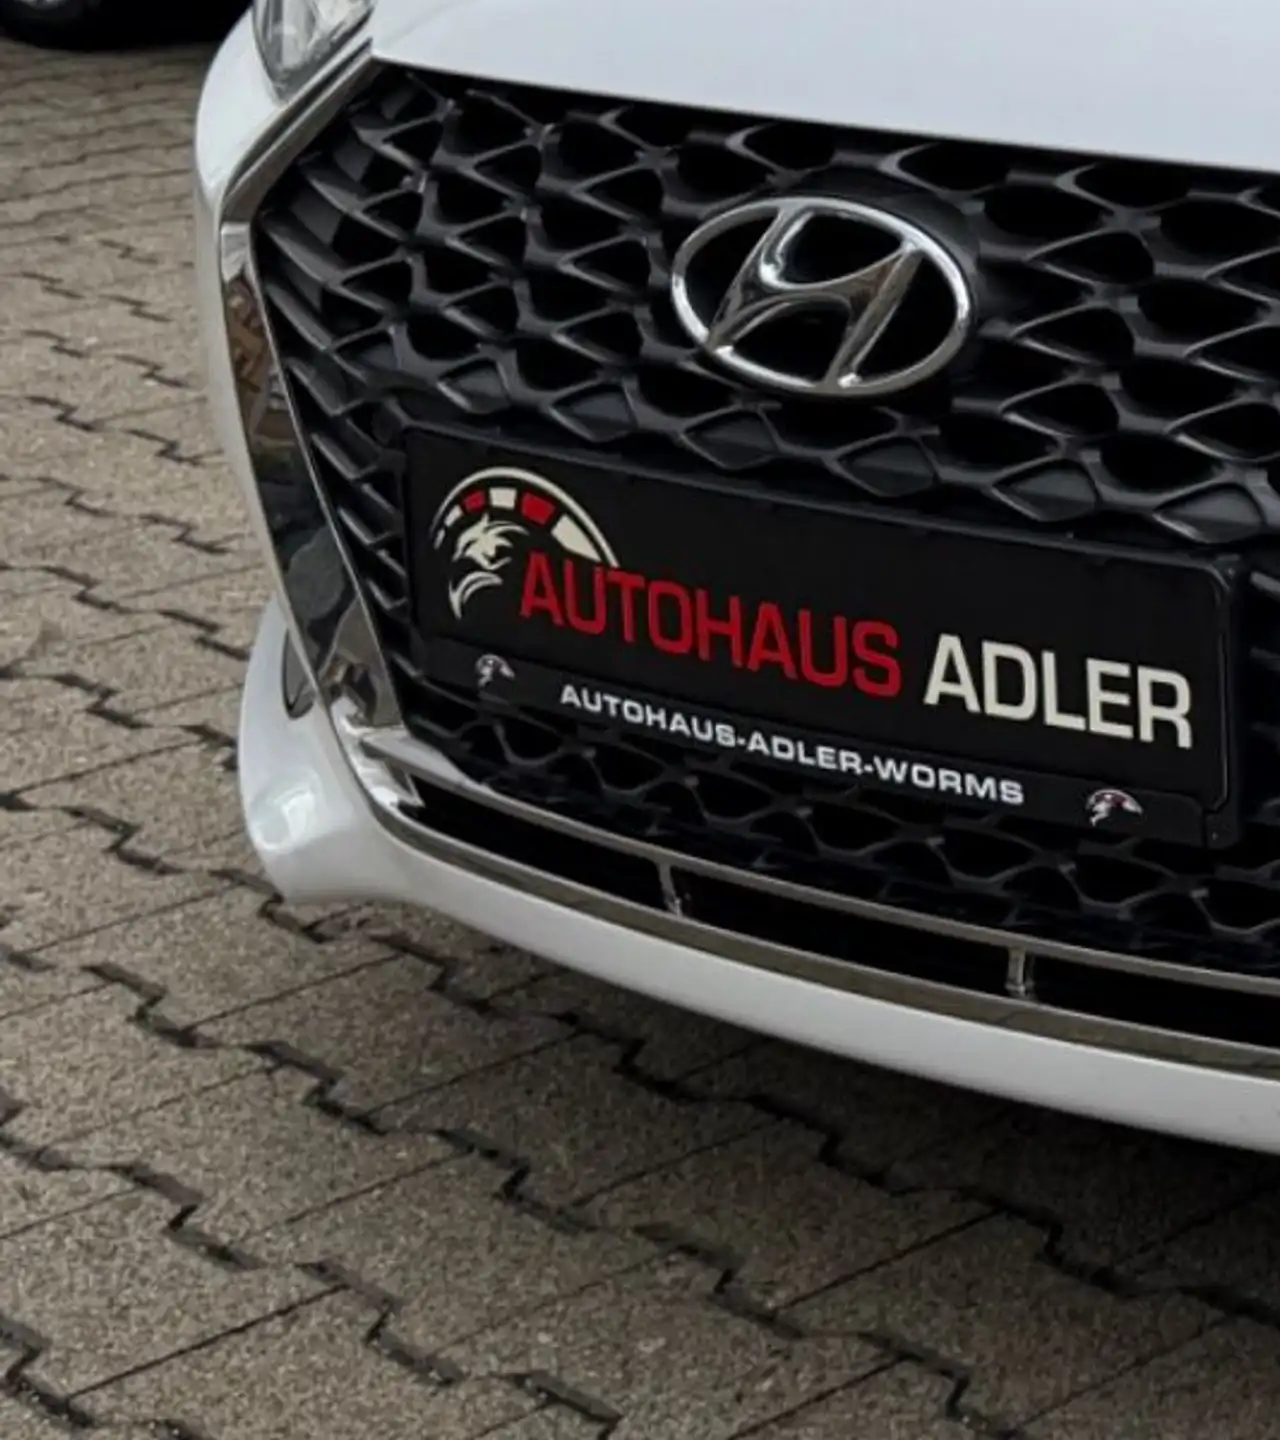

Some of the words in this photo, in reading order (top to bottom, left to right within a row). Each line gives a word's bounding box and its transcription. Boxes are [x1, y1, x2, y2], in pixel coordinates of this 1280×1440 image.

[519, 550, 902, 700] AUTOHAUS
[922, 633, 1193, 750] ADLER
[560, 684, 1026, 806] AUTOHAUS-ADLER-WORMS
